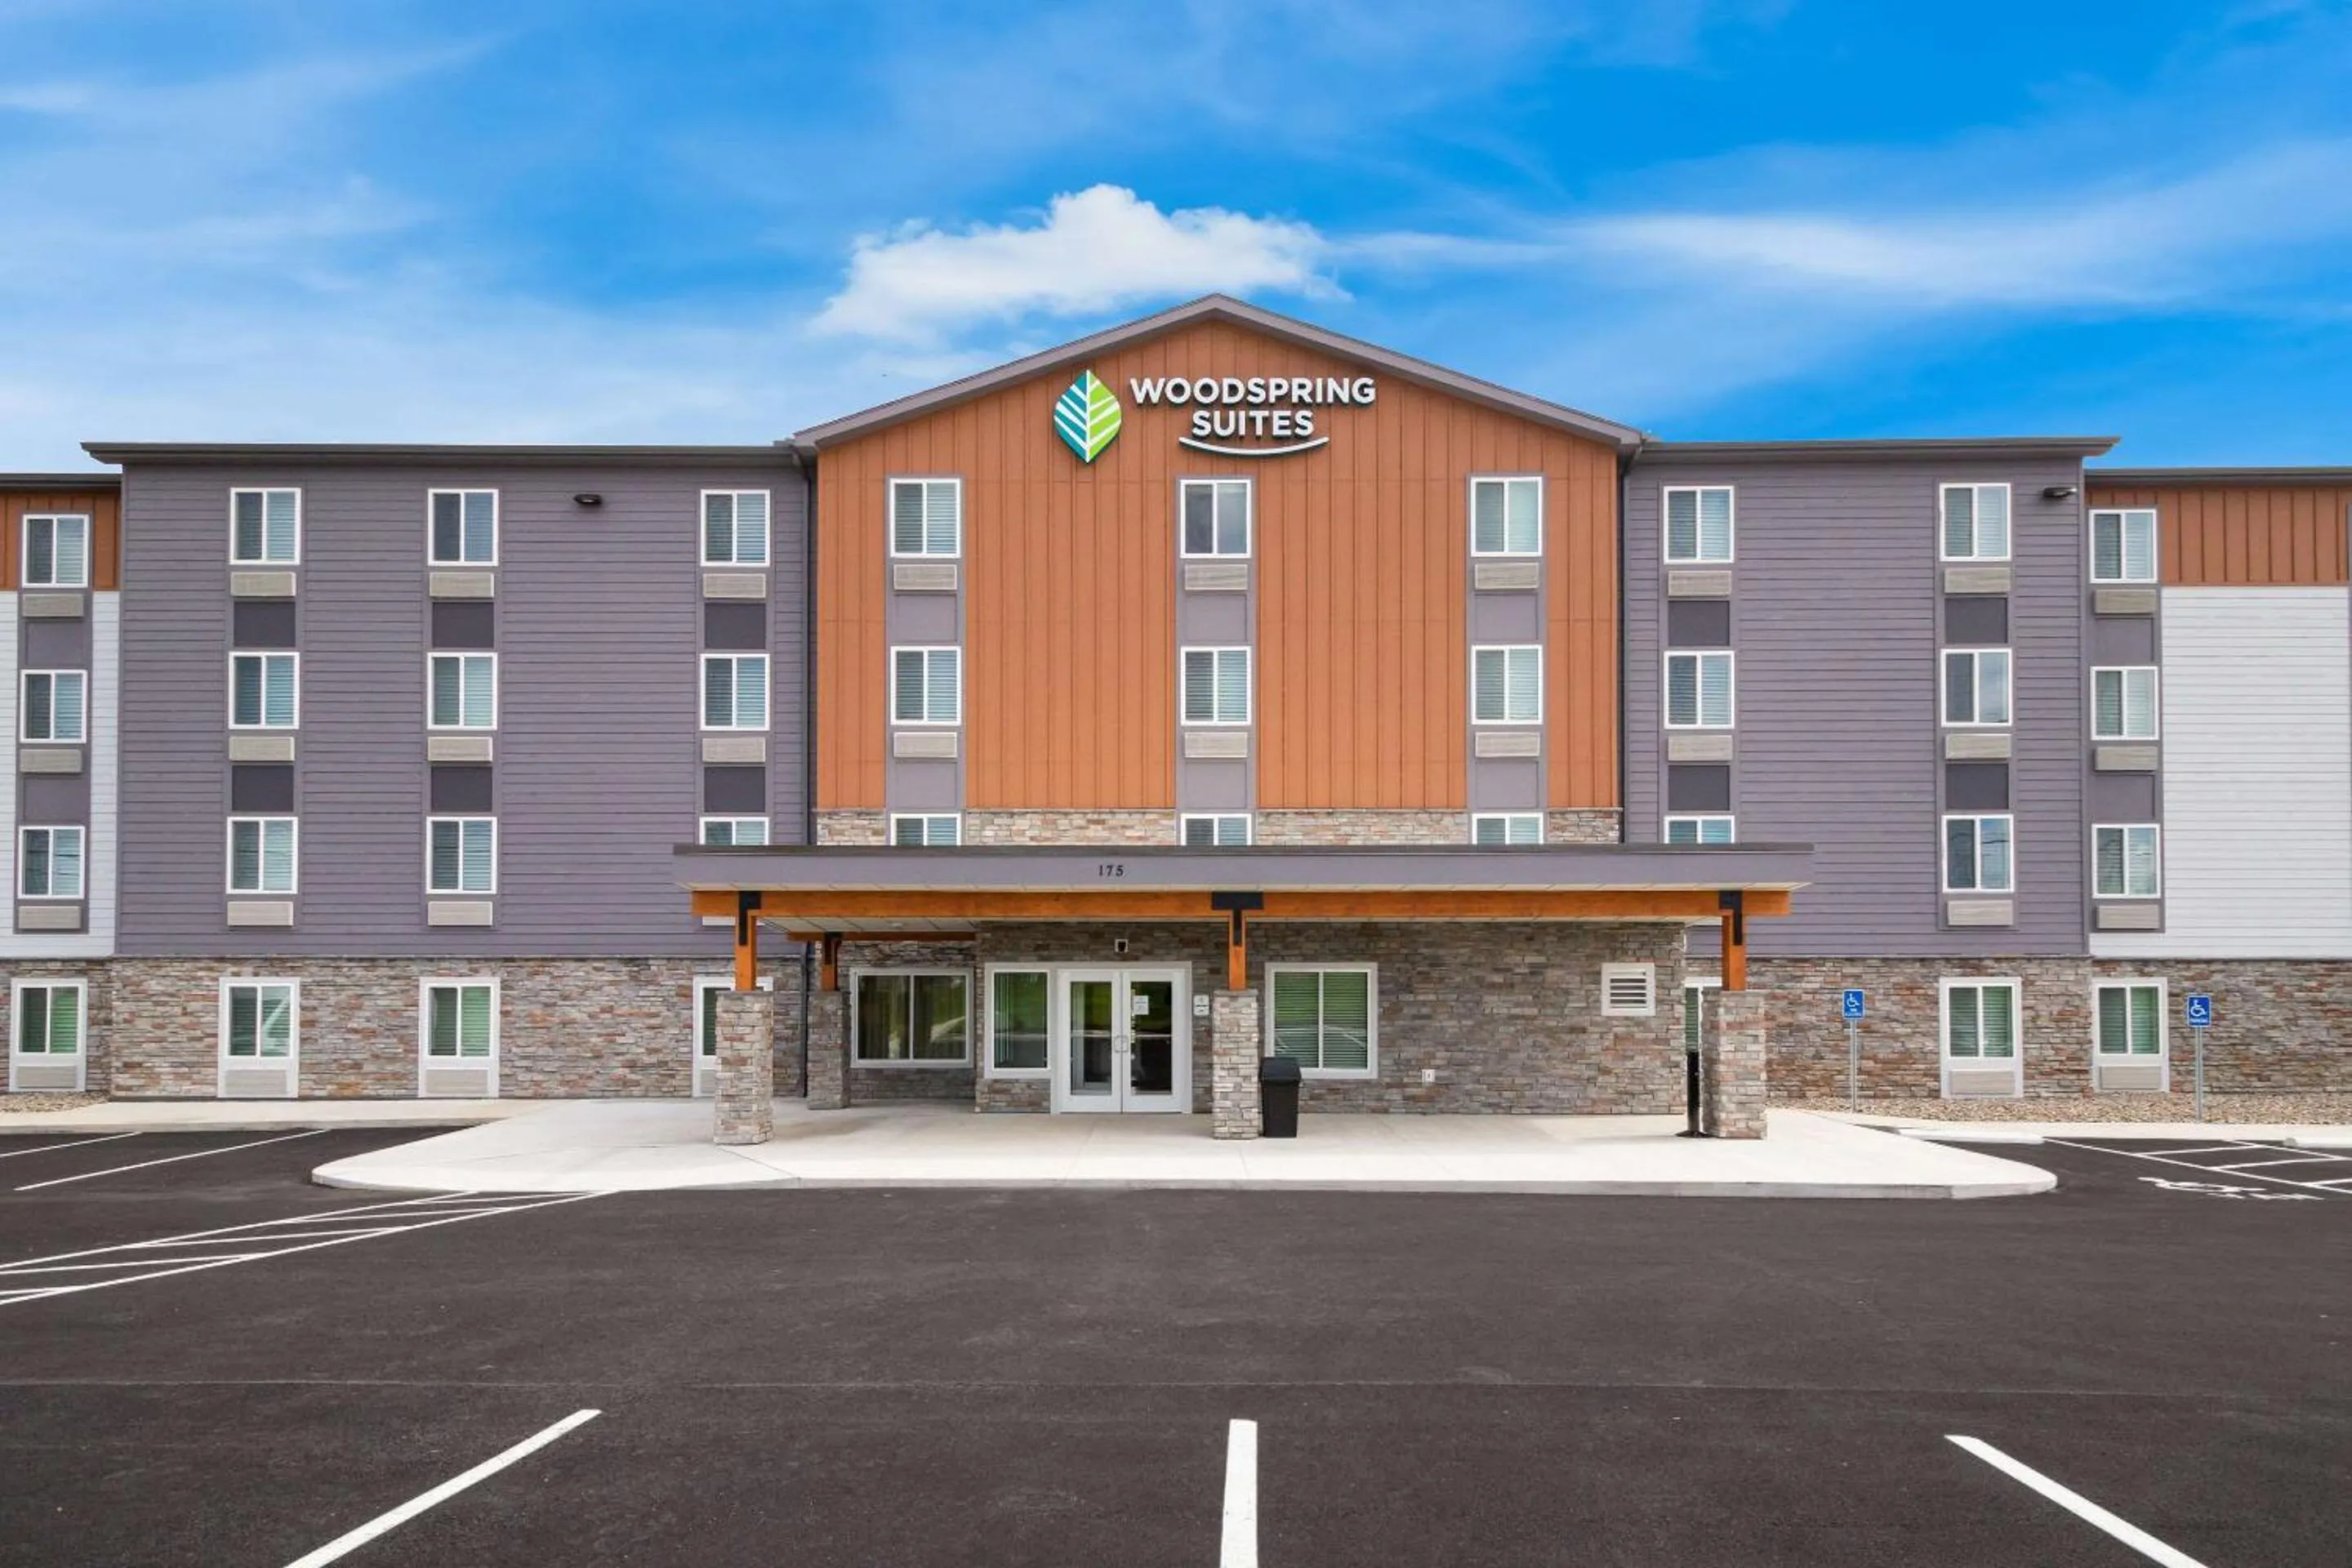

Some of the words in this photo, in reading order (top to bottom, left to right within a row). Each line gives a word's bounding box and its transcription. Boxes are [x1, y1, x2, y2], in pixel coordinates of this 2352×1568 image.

[1129, 377, 1376, 404] WOODSPRING
[1192, 410, 1315, 436] SUITES
[1098, 865, 1124, 876] 175
